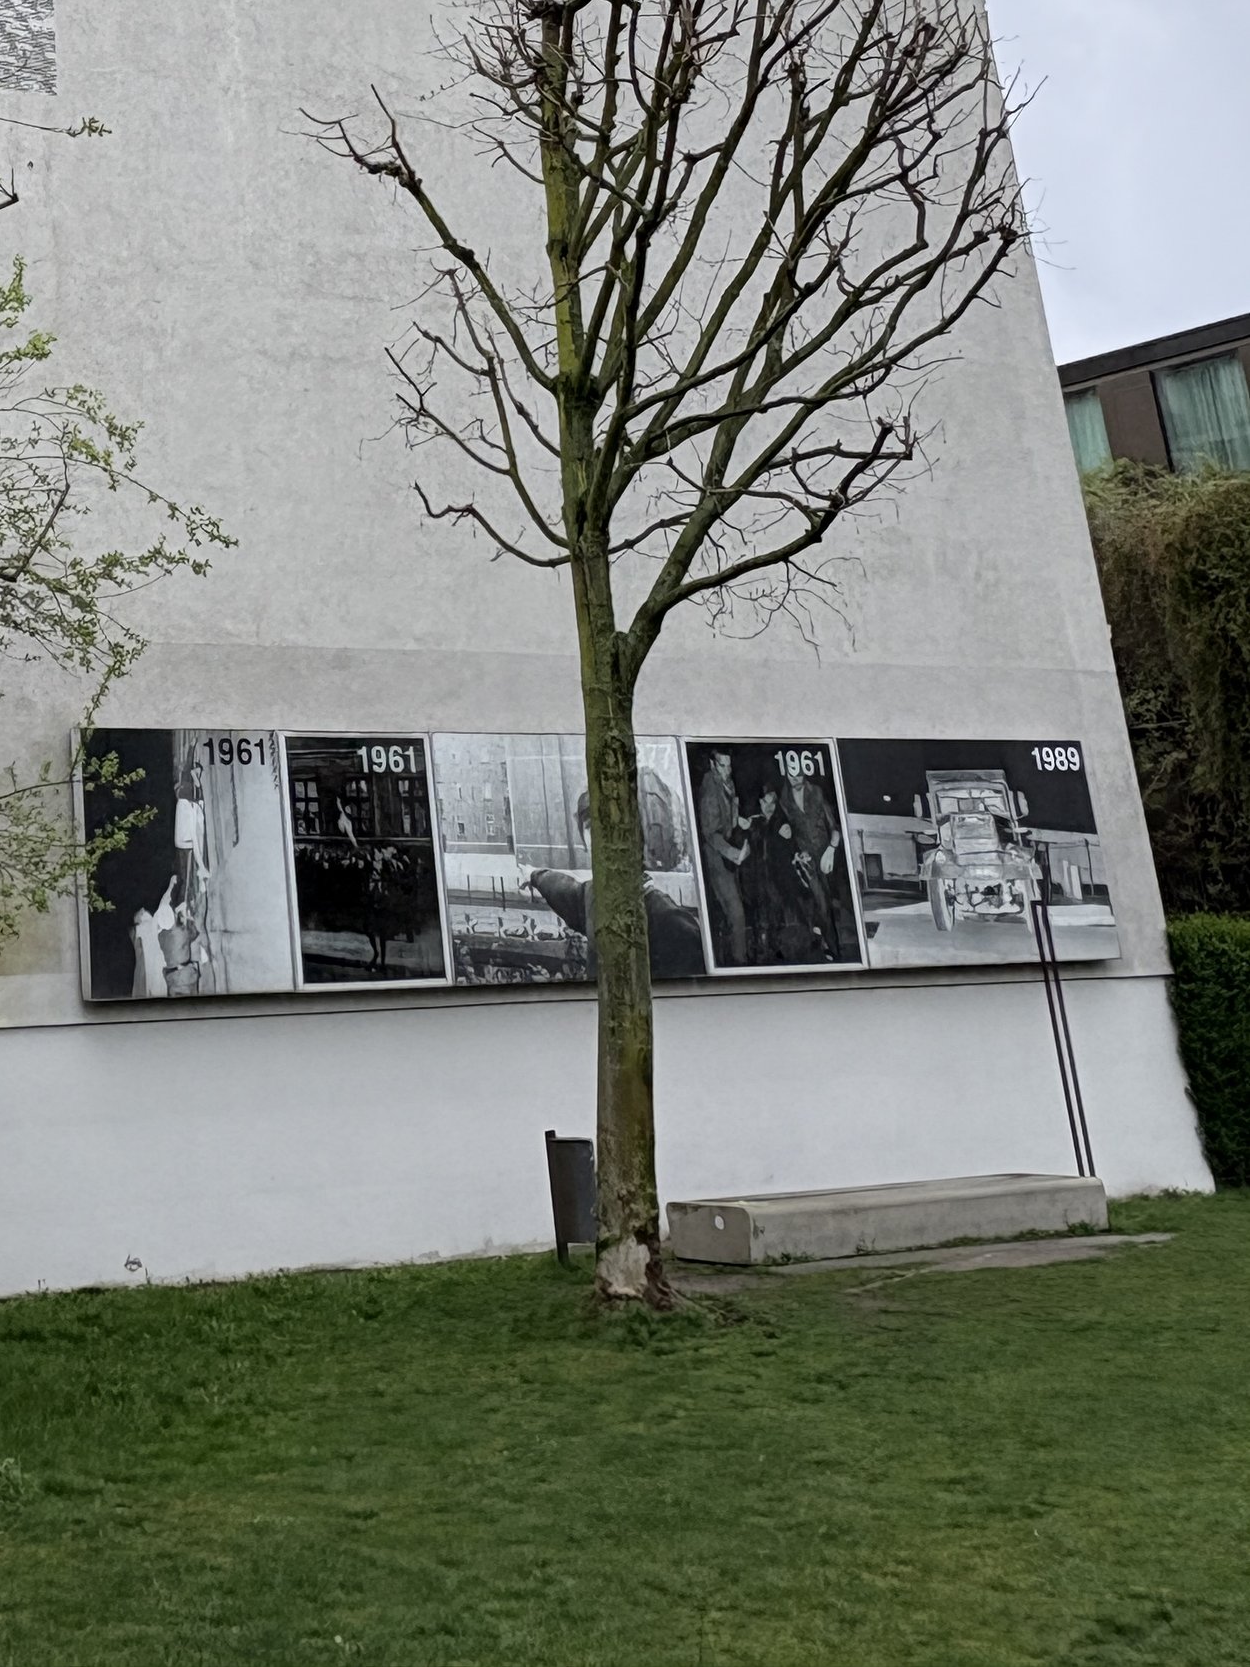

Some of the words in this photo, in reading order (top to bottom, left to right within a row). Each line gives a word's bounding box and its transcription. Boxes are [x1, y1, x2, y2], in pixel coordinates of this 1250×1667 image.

[203, 737, 267, 766] 1961
[357, 745, 418, 774] 1961
[774, 750, 826, 777] 1961
[1031, 747, 1080, 771] 1989
